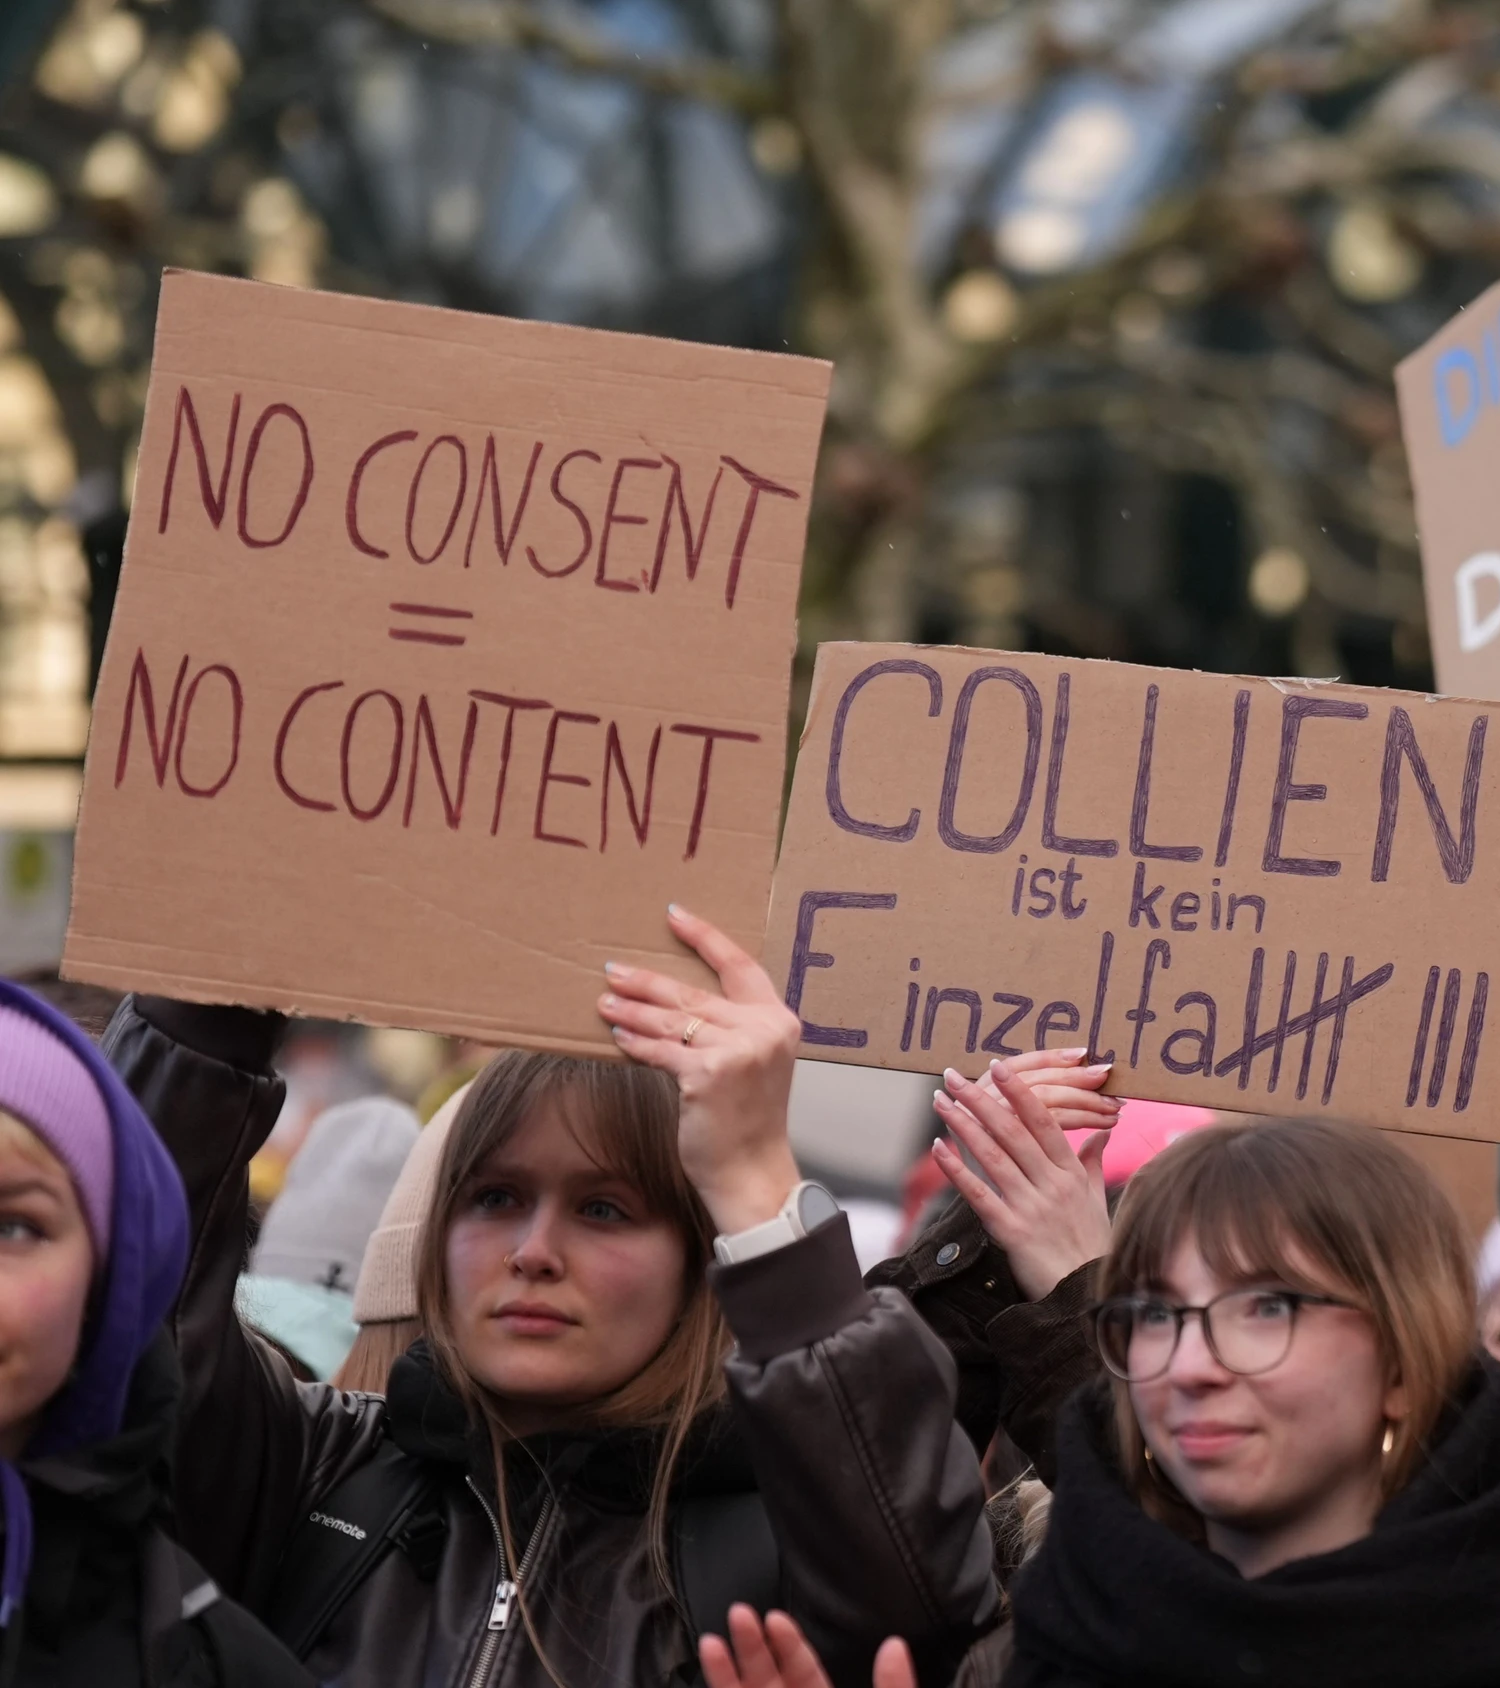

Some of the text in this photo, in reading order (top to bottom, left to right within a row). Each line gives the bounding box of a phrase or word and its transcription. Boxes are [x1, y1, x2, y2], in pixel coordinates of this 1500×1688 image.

[158, 385, 800, 610] NO CONSENT
[114, 647, 761, 860] NO CONTENT
[825, 658, 1488, 886] COLLIEN
[1011, 854, 1266, 934] ist kein
[309, 1511, 367, 1540] onemate
